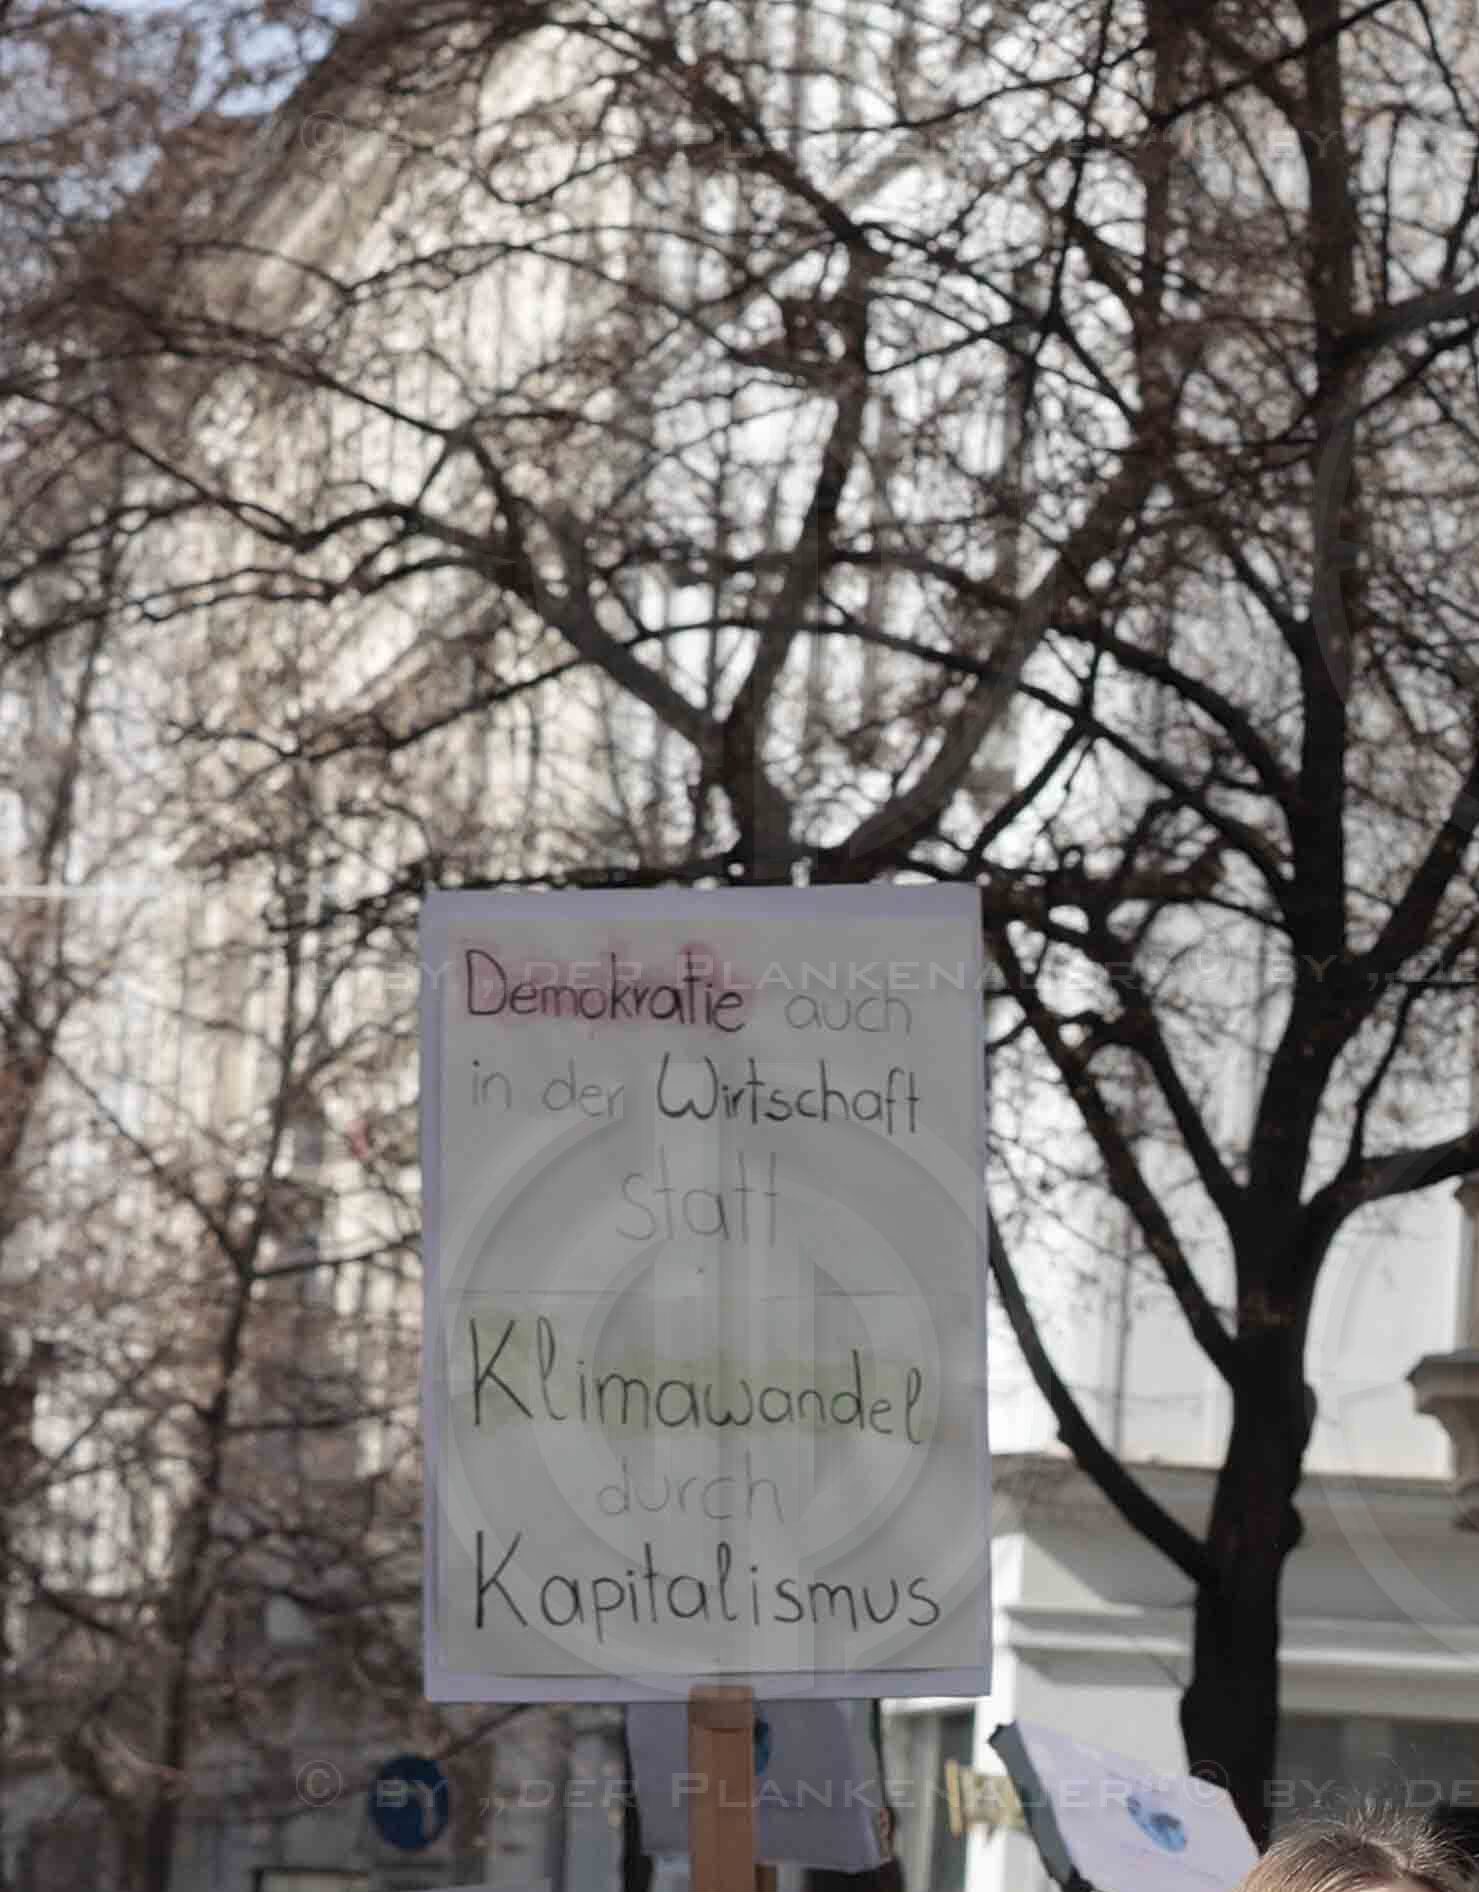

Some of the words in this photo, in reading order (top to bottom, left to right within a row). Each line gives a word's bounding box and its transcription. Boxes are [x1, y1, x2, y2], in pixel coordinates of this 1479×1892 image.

[466, 948, 745, 1032] Demokratie
[785, 976, 913, 1034] auch
[471, 1060, 512, 1110] in
[542, 1058, 624, 1118] der
[657, 1053, 919, 1135] Wirtschaft
[469, 1317, 921, 1444] Klimawandel
[598, 1450, 784, 1523] durch
[476, 1531, 941, 1643] Kapitalismus
